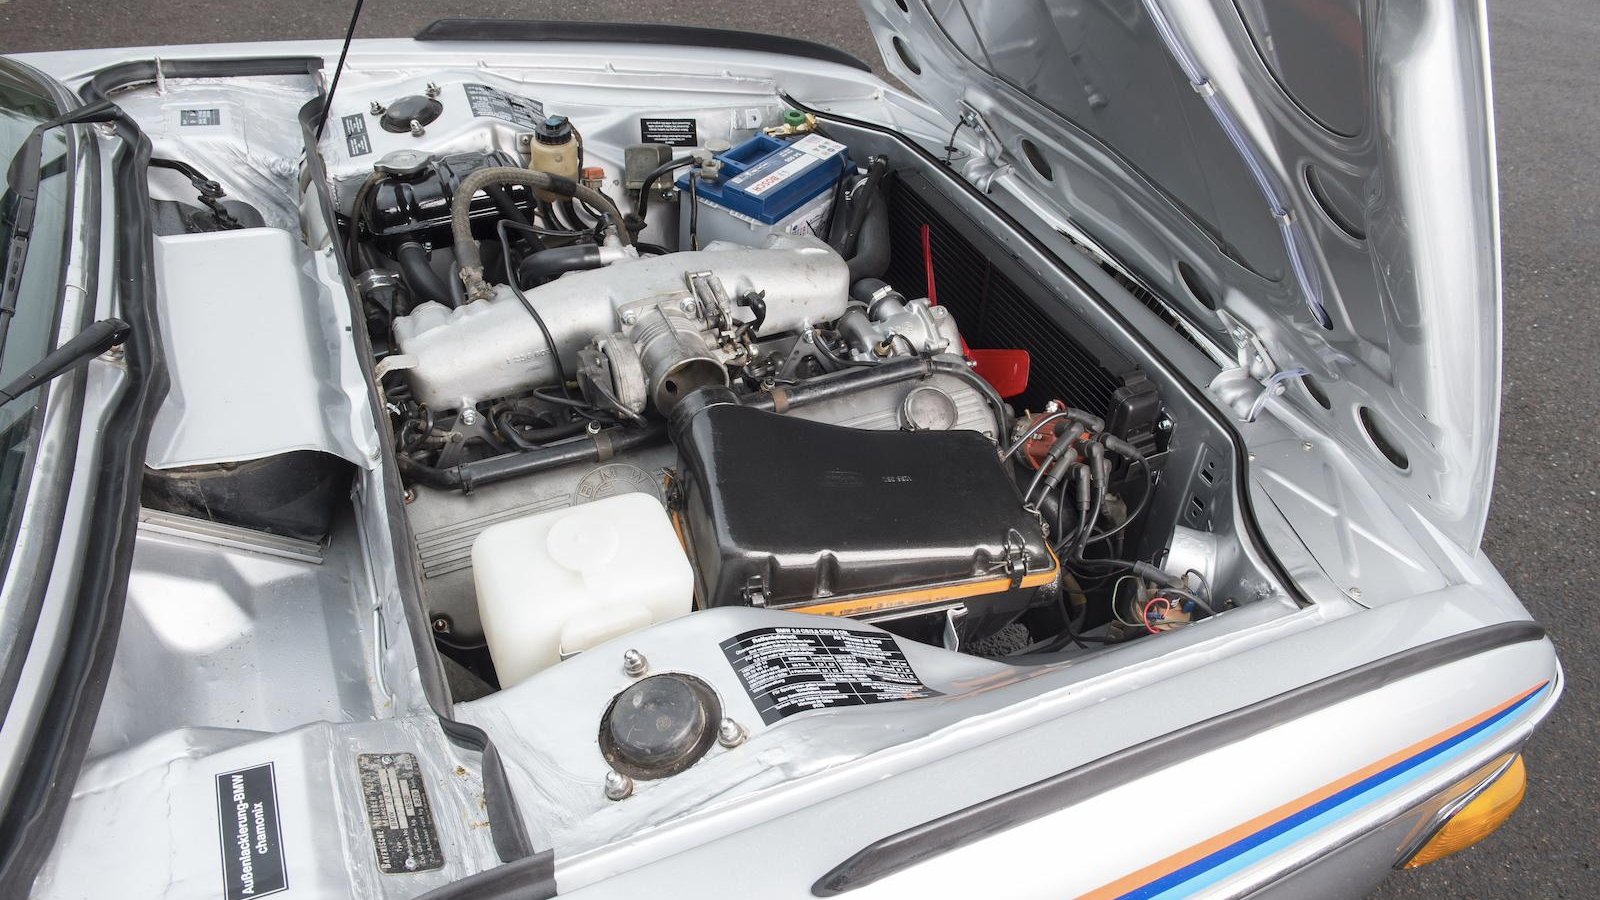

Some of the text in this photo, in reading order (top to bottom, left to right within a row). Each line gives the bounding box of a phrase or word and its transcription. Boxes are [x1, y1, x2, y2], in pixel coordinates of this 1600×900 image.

[752, 175, 780, 192] BOSCH
[579, 467, 649, 499] BMW
[412, 791, 421, 804] 820
[252, 801, 268, 854] chamonix
[388, 811, 396, 826] BMW
[232, 774, 254, 894] Außenlackierung-BMW
[394, 841, 403, 851] Typ
[376, 830, 391, 868] BAYERISCHE
